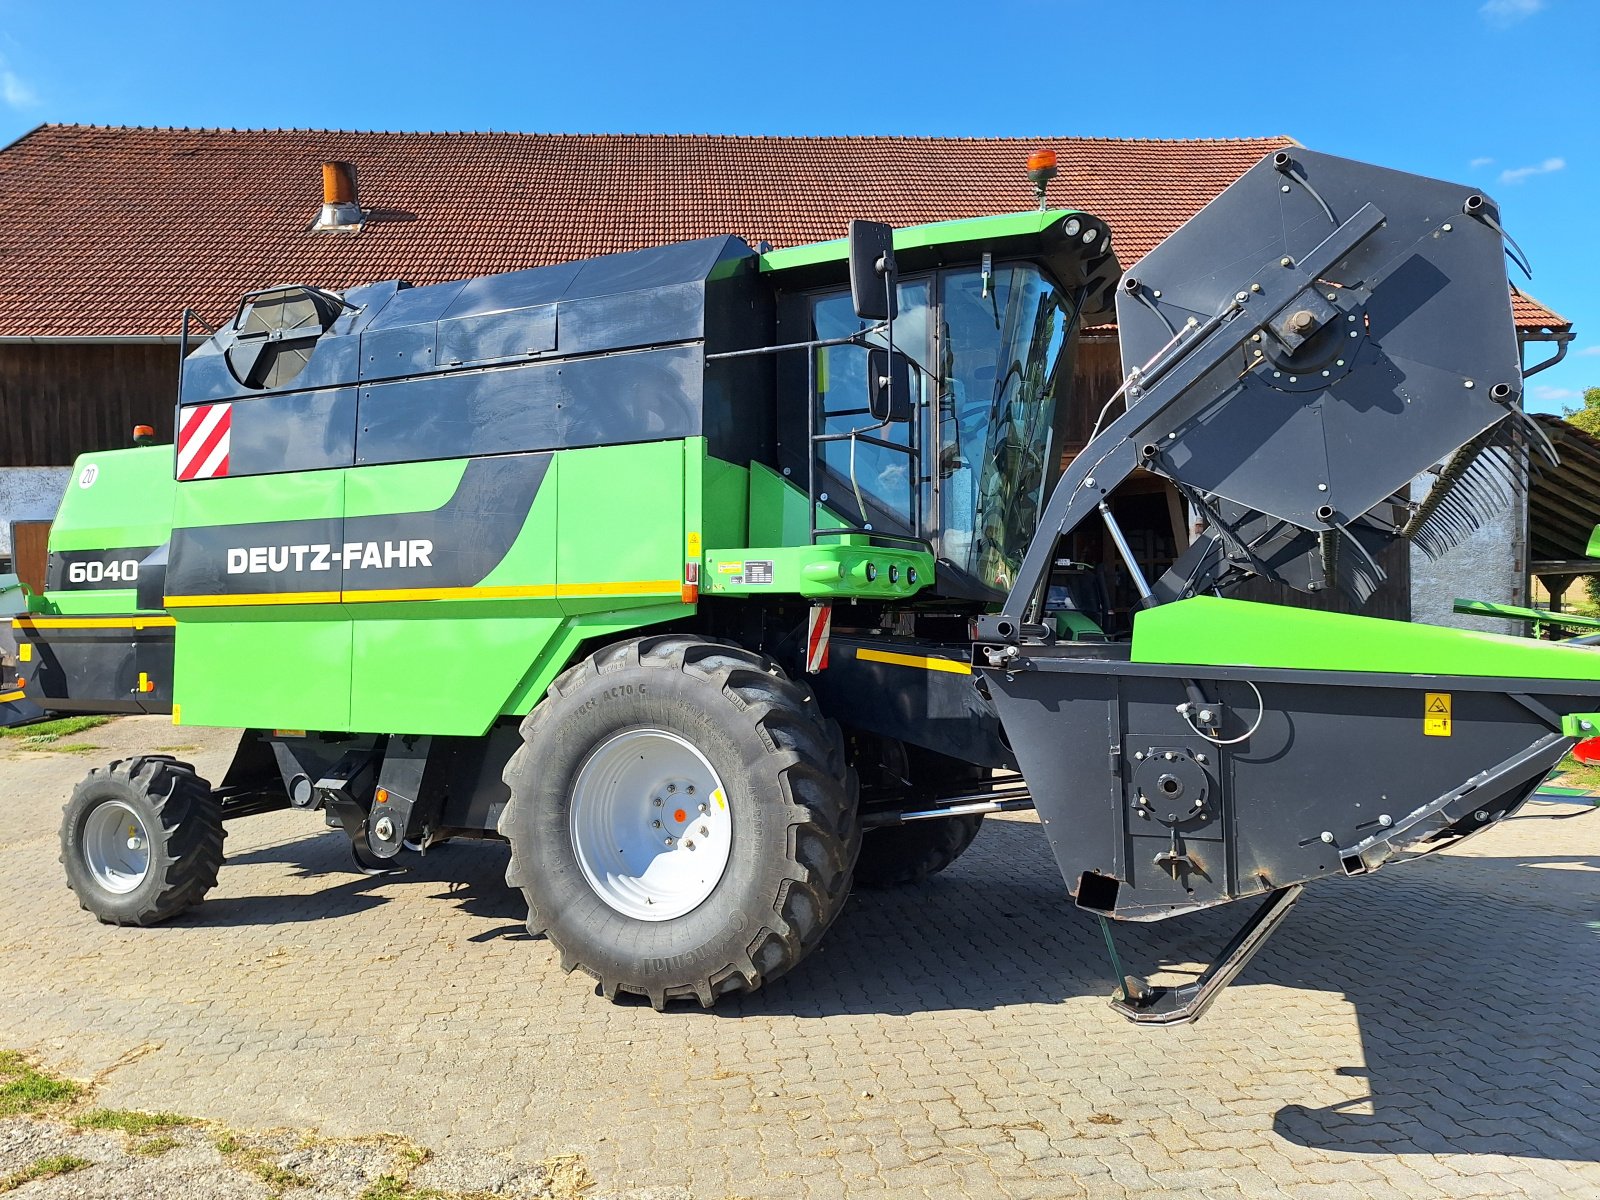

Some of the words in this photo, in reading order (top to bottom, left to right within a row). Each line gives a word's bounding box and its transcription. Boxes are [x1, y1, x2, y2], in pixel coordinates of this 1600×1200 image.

[82, 468, 96, 484] 20
[227, 539, 434, 574] DEUTZ-FAHR
[69, 560, 139, 583] 6040
[603, 684, 634, 701] AC70
[638, 683, 647, 694] G
[723, 687, 748, 711] RADIAL
